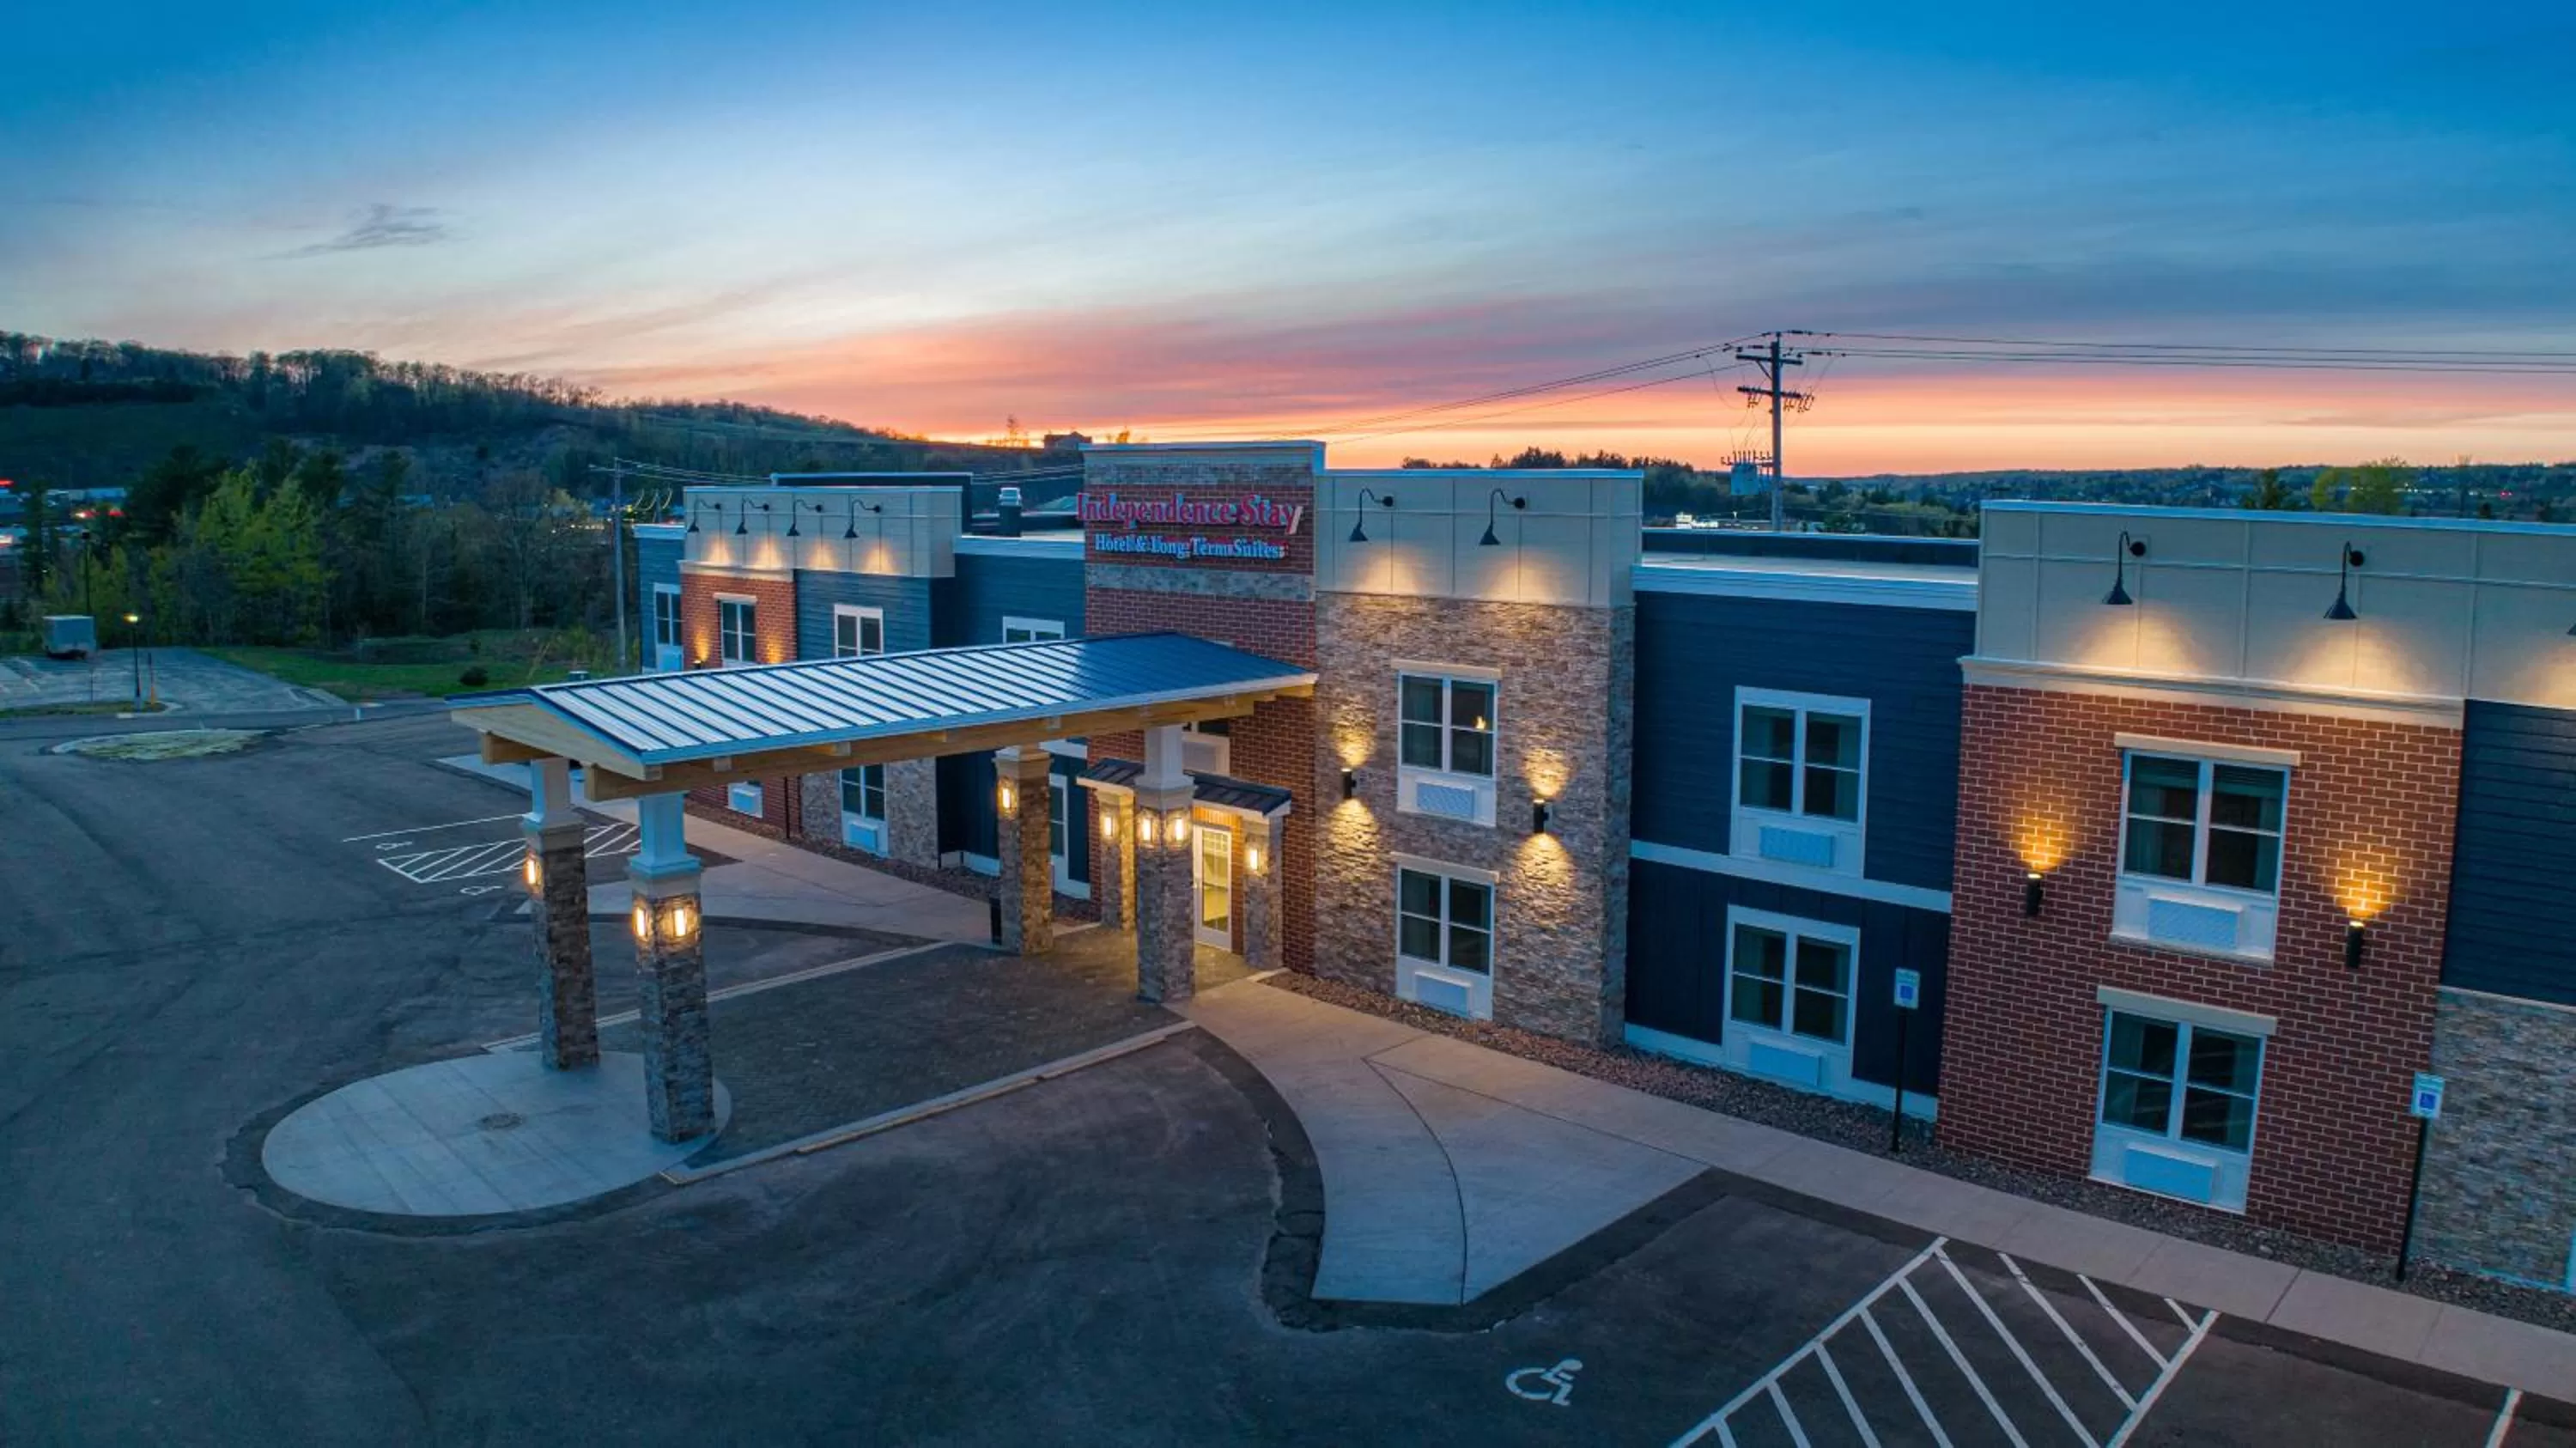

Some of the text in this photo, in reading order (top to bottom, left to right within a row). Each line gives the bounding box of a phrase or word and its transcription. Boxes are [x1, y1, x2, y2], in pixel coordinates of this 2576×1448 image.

[1078, 493, 1303, 534] Independence Stay
[1095, 533, 1285, 559] Hotel & Long Term Suites
